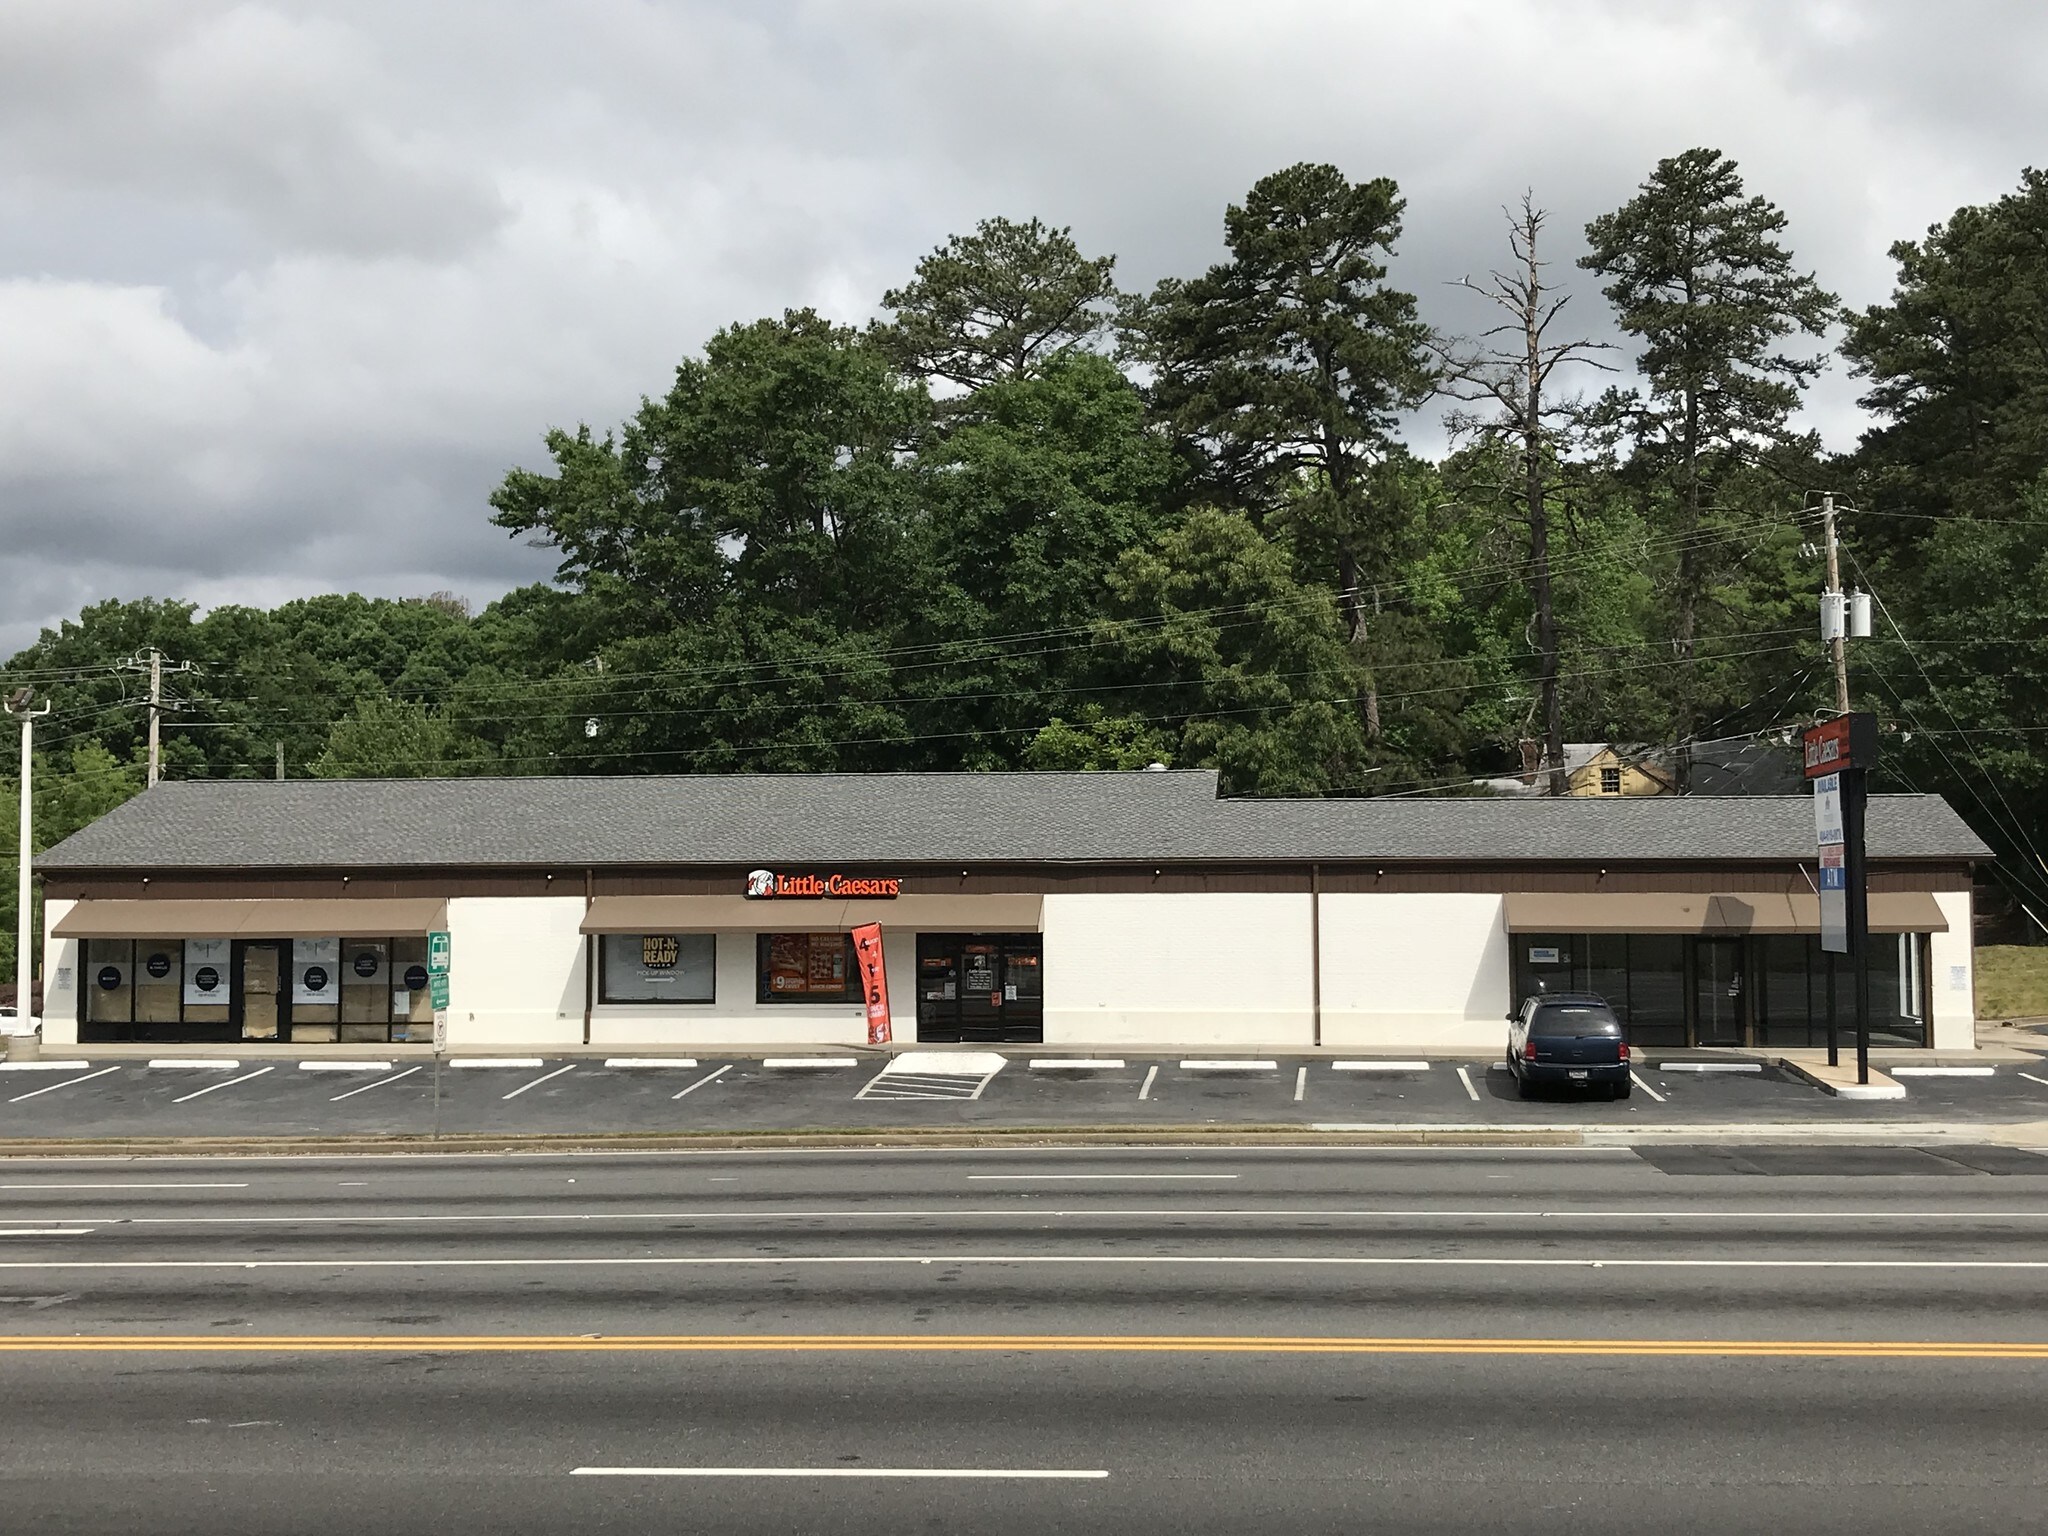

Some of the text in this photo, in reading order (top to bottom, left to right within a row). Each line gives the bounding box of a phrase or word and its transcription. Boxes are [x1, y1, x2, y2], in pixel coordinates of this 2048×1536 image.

[776, 874, 898, 895] Little Caesars
[643, 937, 678, 950] HOT-N-
[643, 950, 677, 963] READY
[870, 985, 880, 1004] 5
